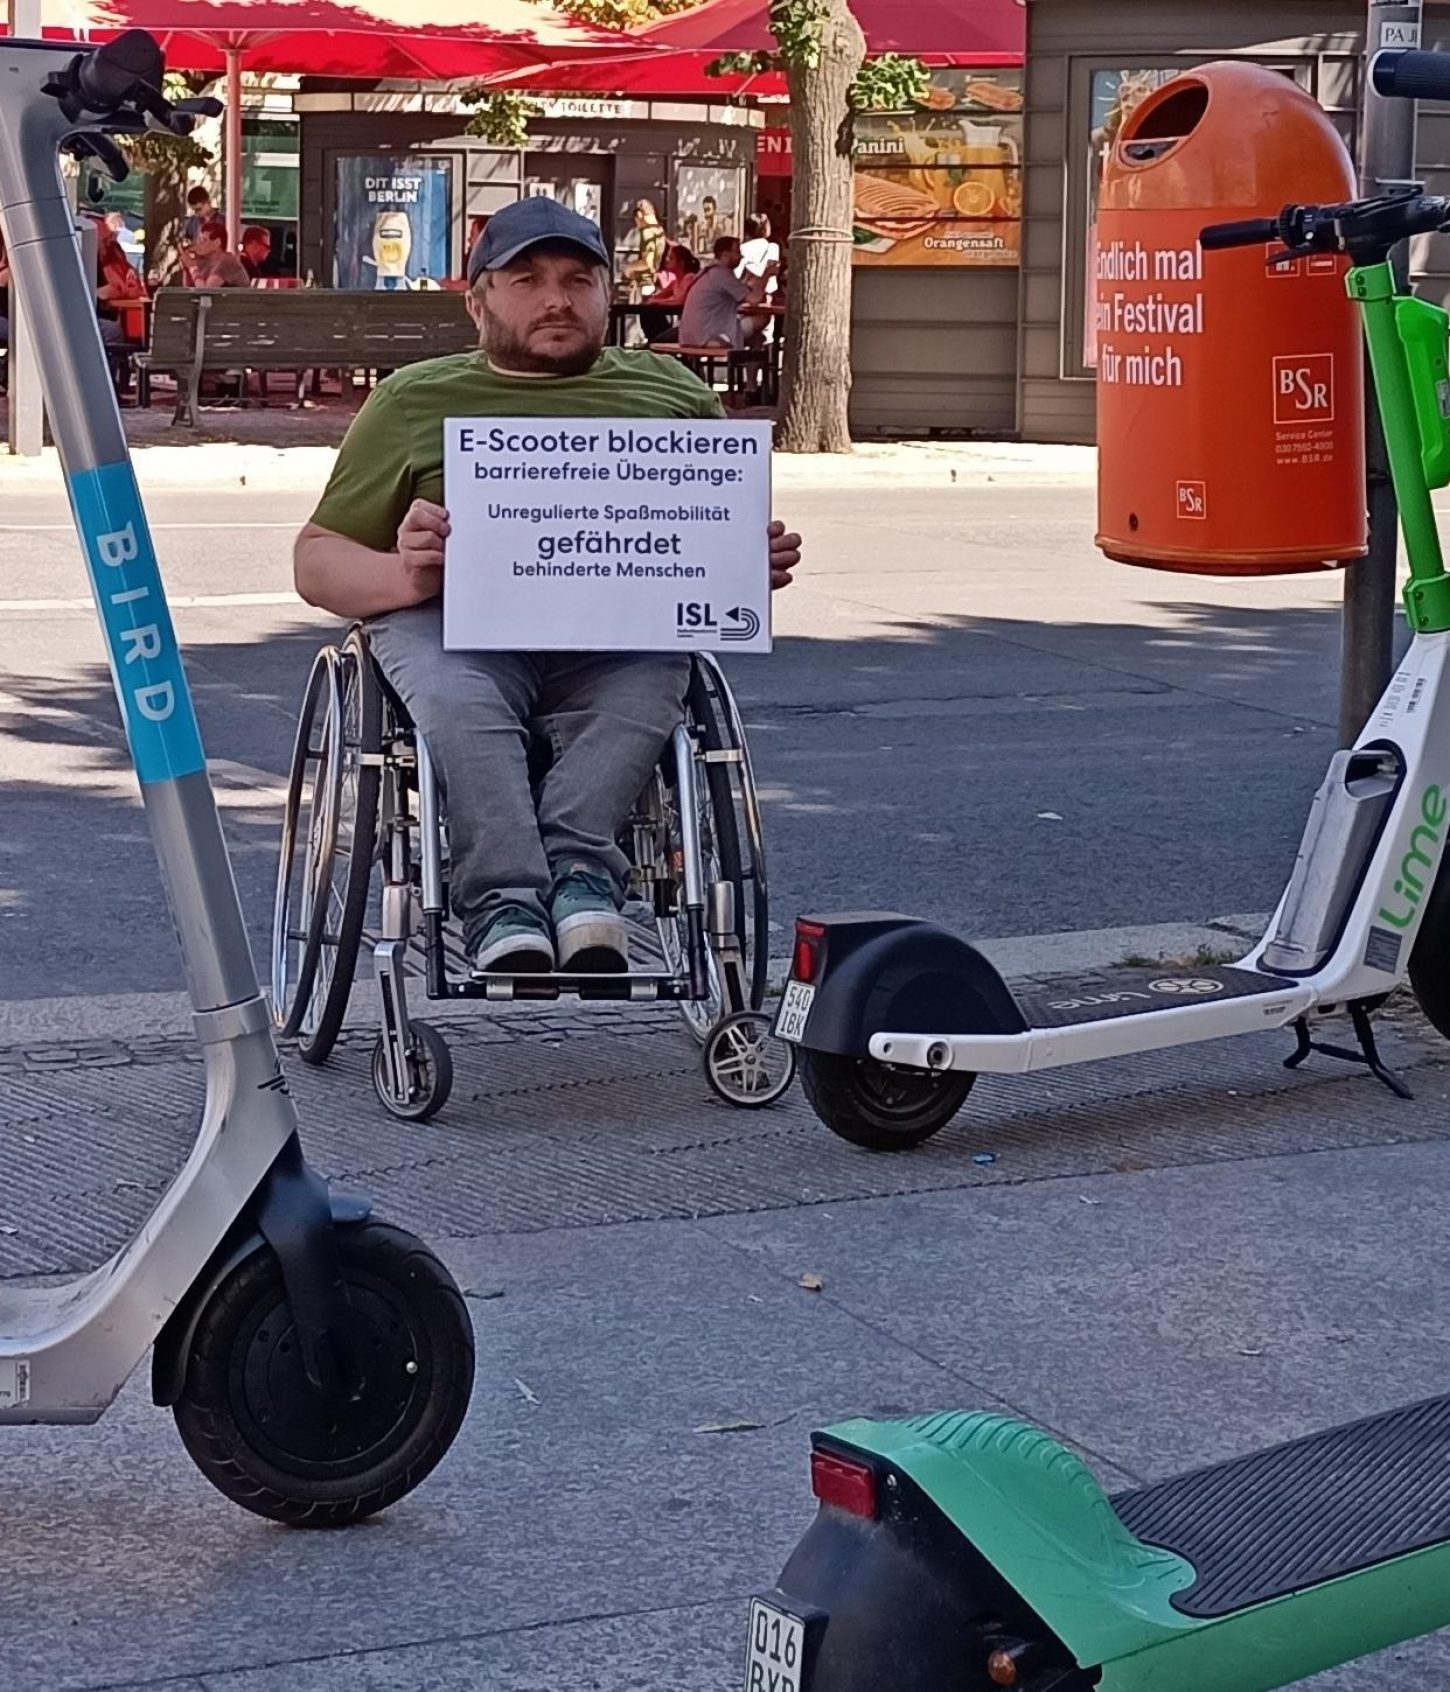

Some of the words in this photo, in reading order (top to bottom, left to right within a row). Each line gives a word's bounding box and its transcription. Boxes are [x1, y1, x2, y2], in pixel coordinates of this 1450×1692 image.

[561, 102, 622, 114] TOILETTE
[365, 177, 388, 189] DIT
[391, 177, 421, 189] ISST
[368, 191, 418, 202] BERLIN
[924, 237, 1004, 251] Orangensaft
[1155, 239, 1203, 280] mal
[1114, 293, 1203, 333] Festival
[1102, 343, 1121, 383] für
[1126, 345, 1182, 386] mich
[1280, 368, 1328, 410] BSR
[459, 428, 599, 453] E-Scooter
[608, 429, 758, 454] blockieren
[1275, 432, 1306, 441] Service
[475, 462, 610, 480] barrierefreie
[617, 459, 743, 486] Übergänge:
[1180, 487, 1203, 512] BSR
[488, 504, 599, 522] Unregulierte
[604, 504, 731, 524] Spaßmobilität
[537, 530, 682, 560] gefährdet
[513, 561, 611, 577] behinderte
[616, 562, 706, 578] Menschen
[96, 520, 175, 721] BIRD
[677, 602, 718, 627] ISL
[1378, 783, 1447, 929] Lime
[787, 985, 811, 1011] 540
[755, 1610, 796, 1668] 016
